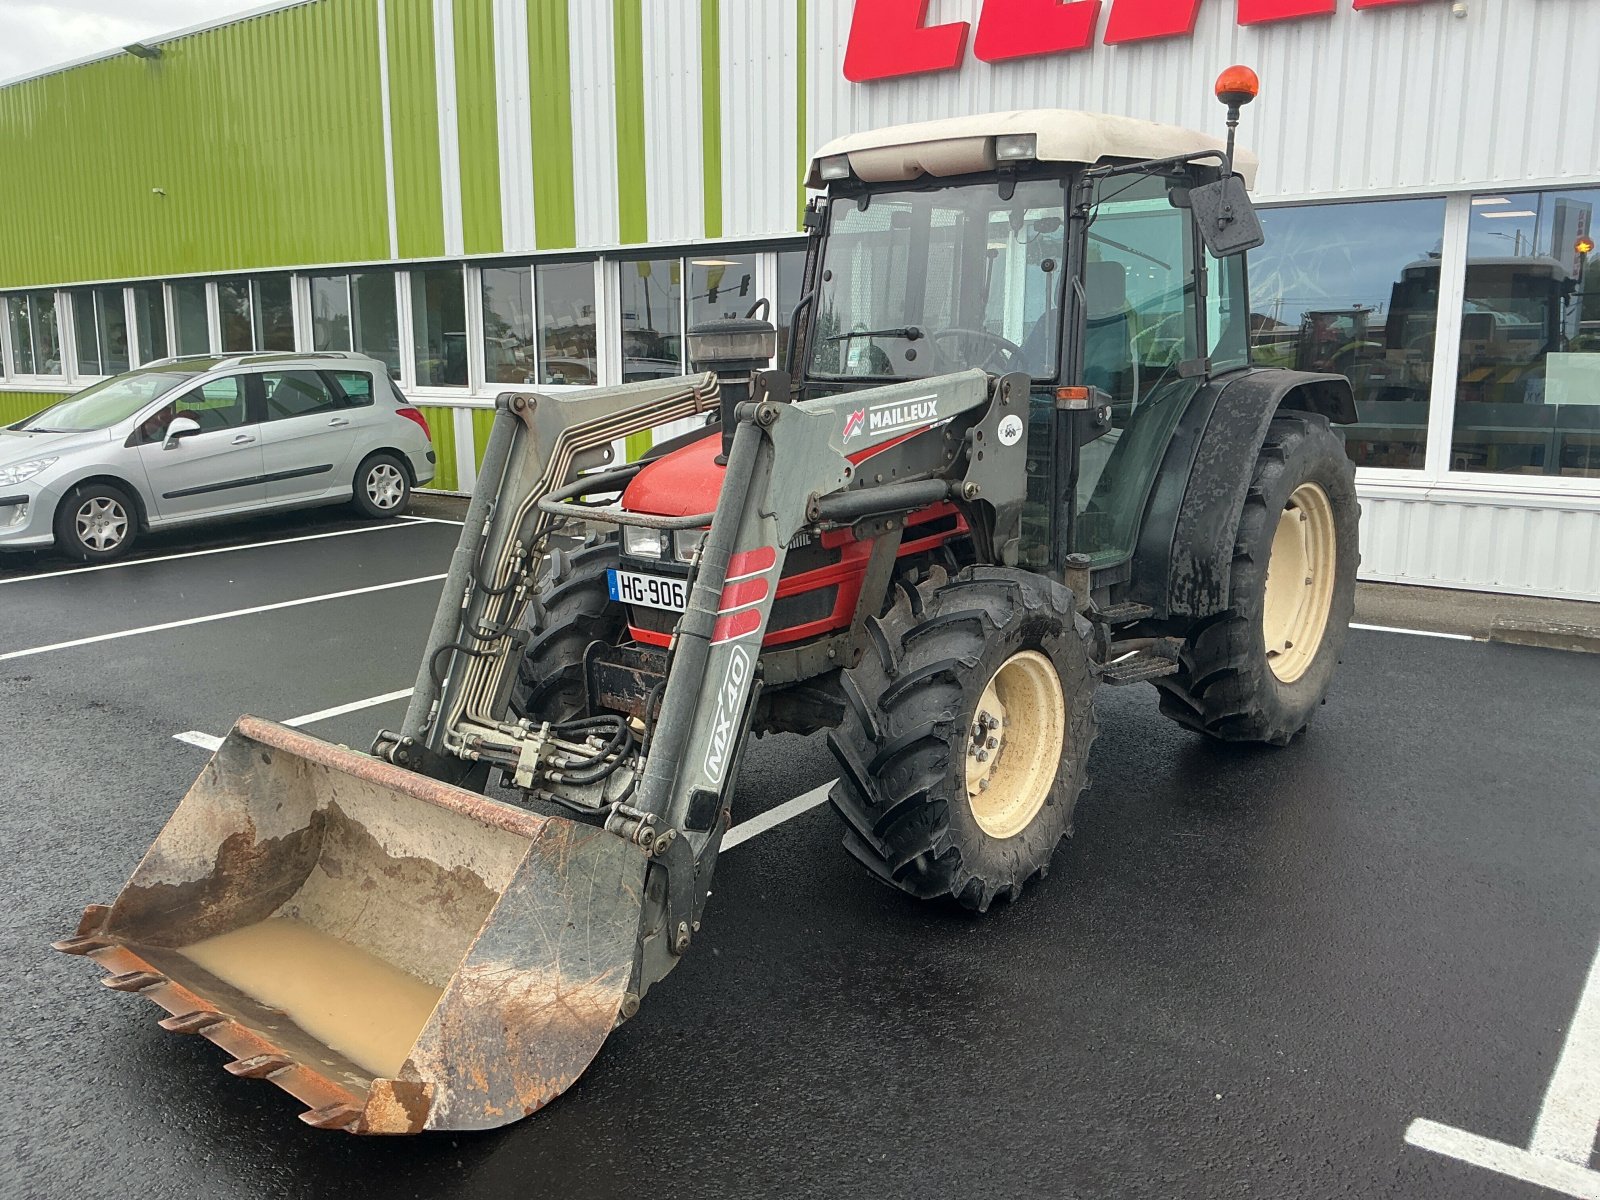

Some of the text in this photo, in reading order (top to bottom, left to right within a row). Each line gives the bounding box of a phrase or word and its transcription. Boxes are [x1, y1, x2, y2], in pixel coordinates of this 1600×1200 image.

[869, 400, 938, 430] MAILLEUX
[708, 654, 744, 775] MX 40
